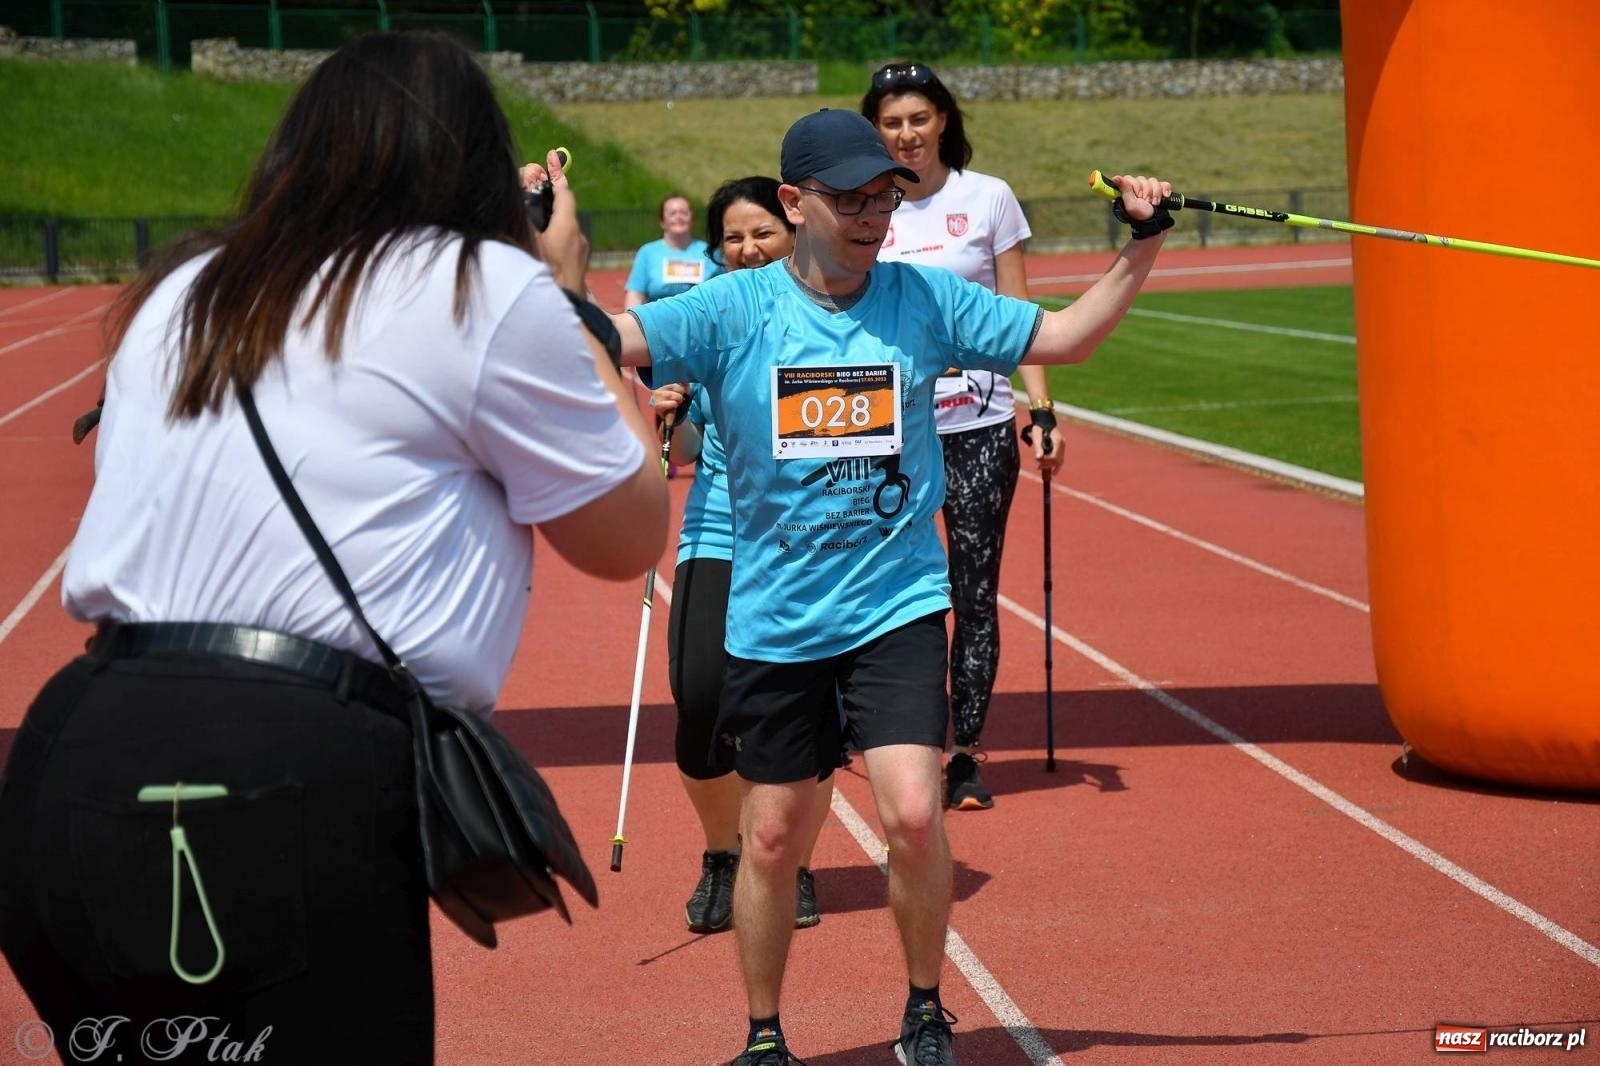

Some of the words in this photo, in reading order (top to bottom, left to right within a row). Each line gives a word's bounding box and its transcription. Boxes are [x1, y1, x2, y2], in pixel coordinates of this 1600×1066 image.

[1225, 203, 1273, 218] GABEL
[784, 371, 795, 379] VIII
[801, 395, 871, 427] 028
[826, 456, 871, 484] VIII
[822, 485, 871, 496] RACIBORSKI
[852, 497, 870, 506] BIEG
[825, 511, 840, 520] BEZ
[843, 508, 870, 518] BARIER
